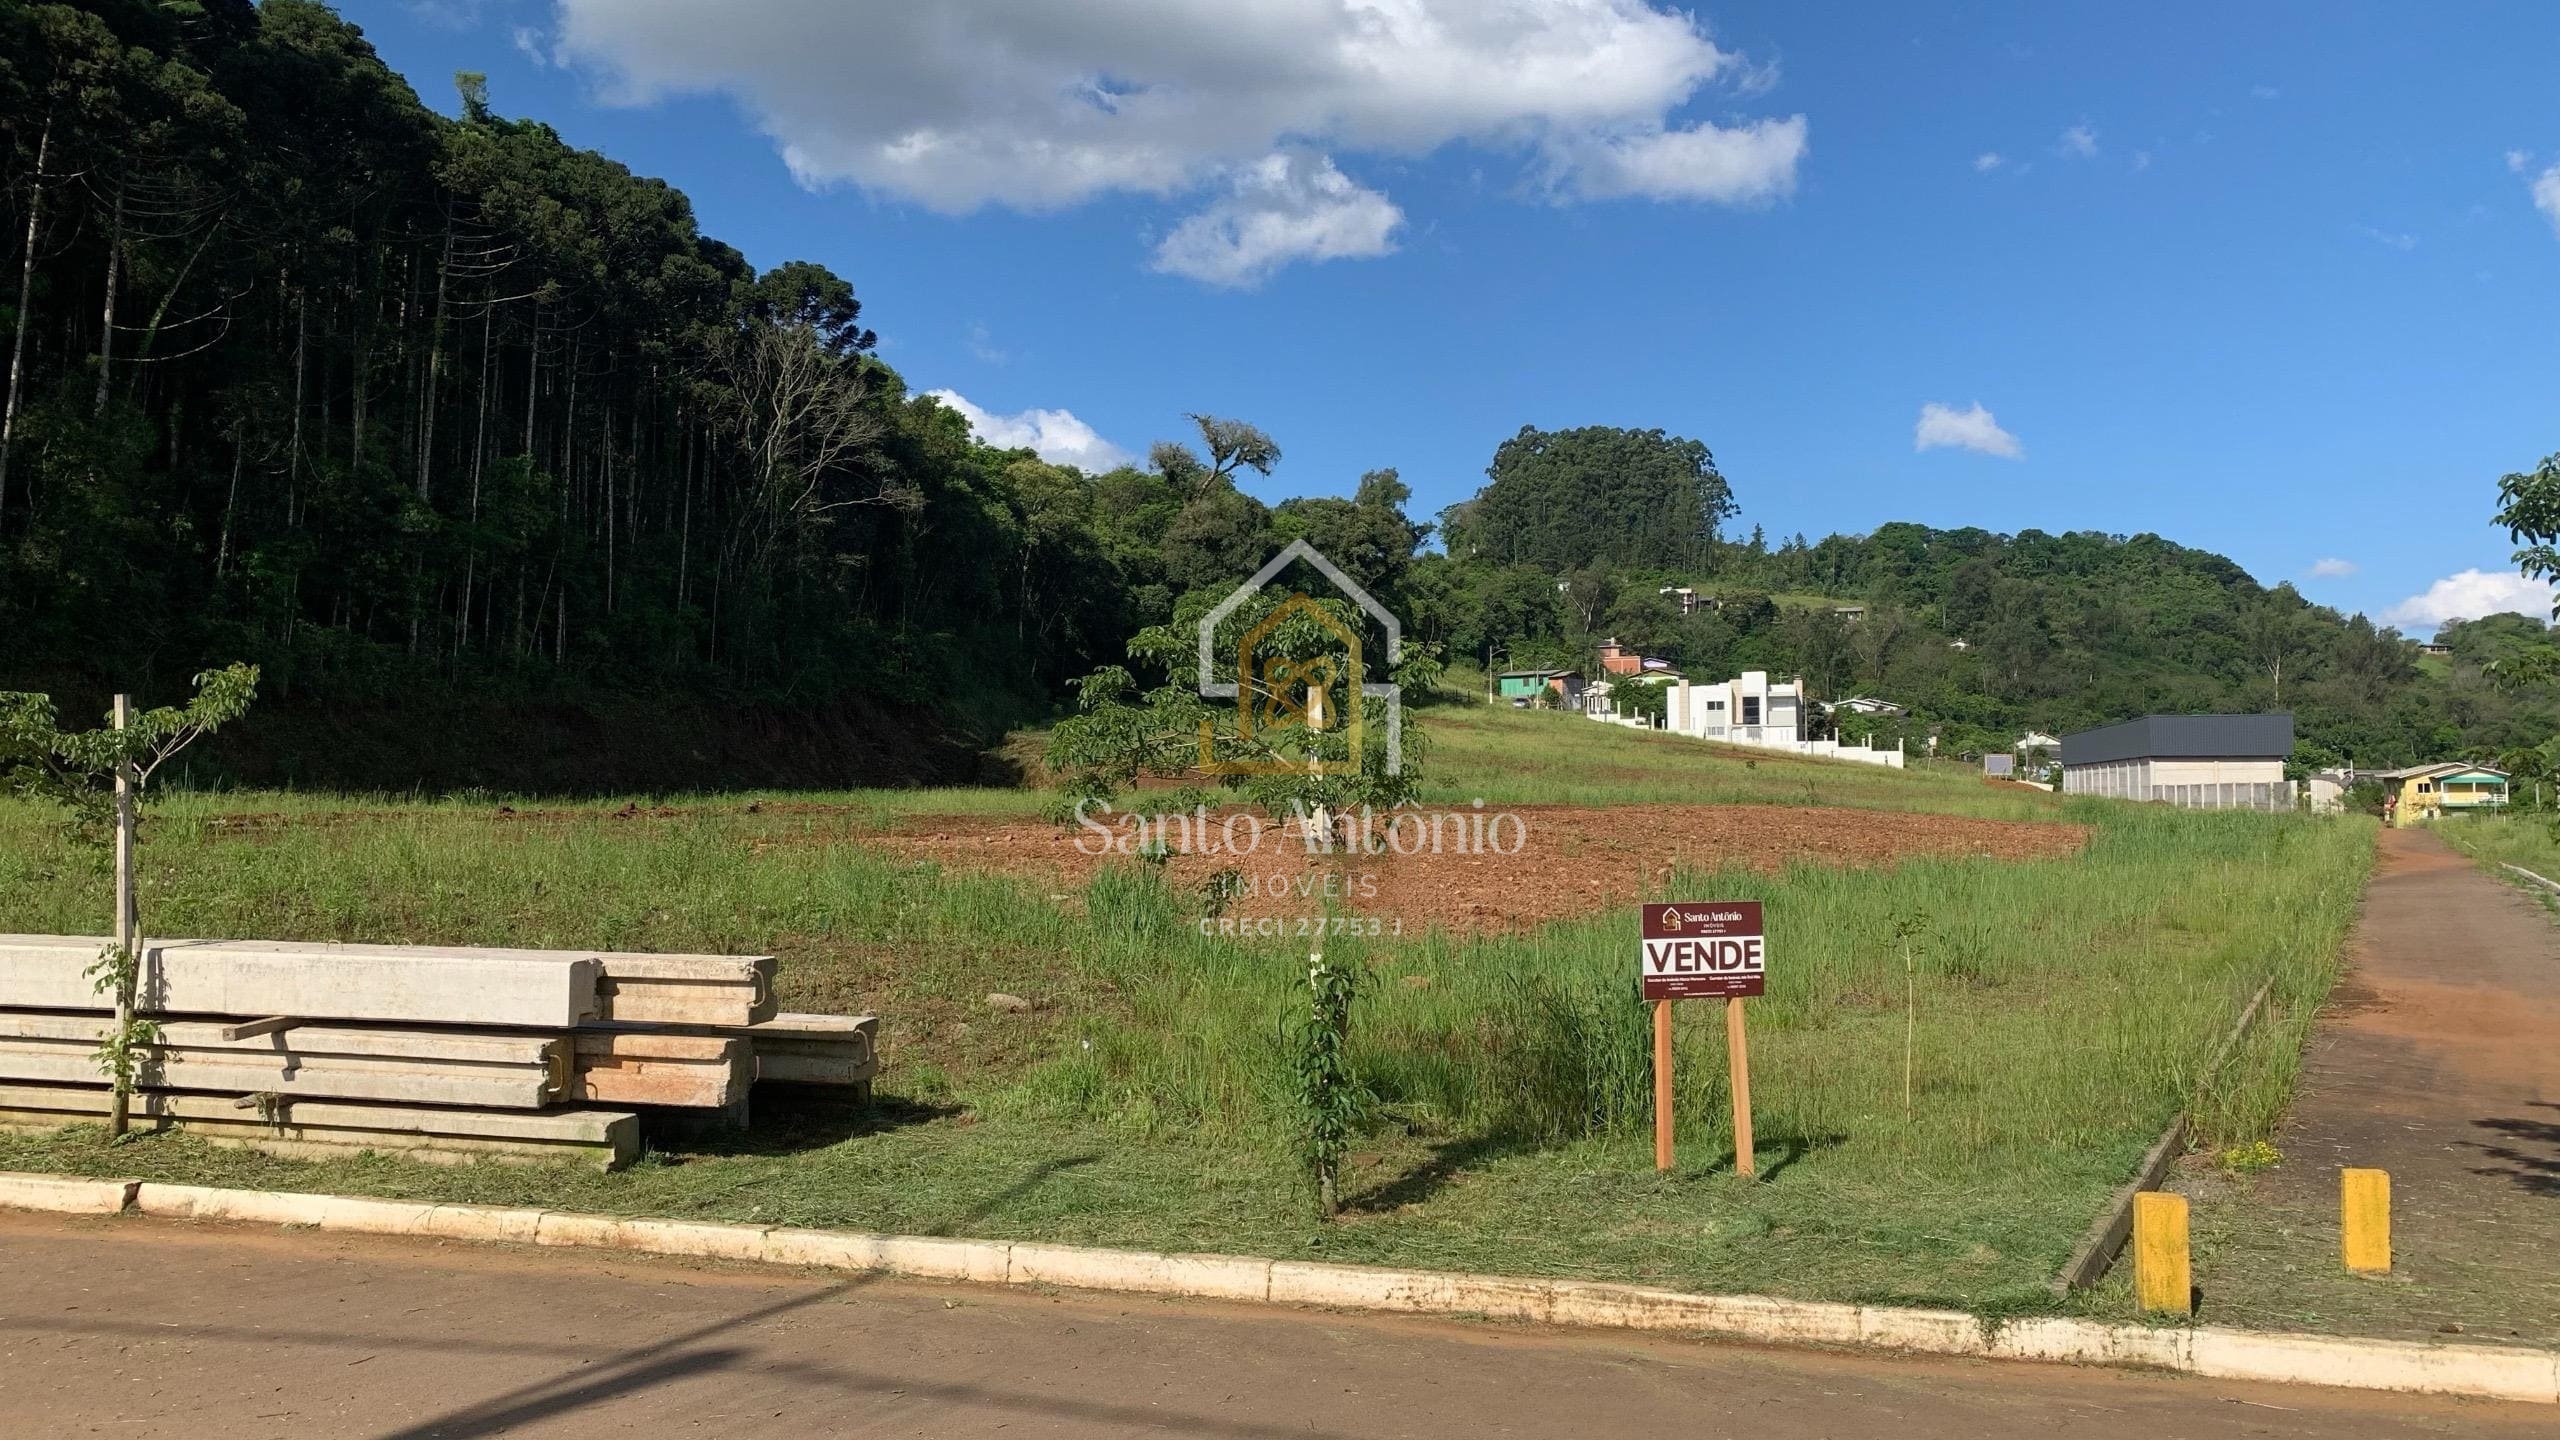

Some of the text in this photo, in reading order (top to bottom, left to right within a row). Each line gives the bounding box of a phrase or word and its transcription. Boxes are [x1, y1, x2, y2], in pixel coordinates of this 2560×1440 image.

[1684, 911, 1743, 922] Santo Antônio
[1646, 939, 1762, 973] VENDE
